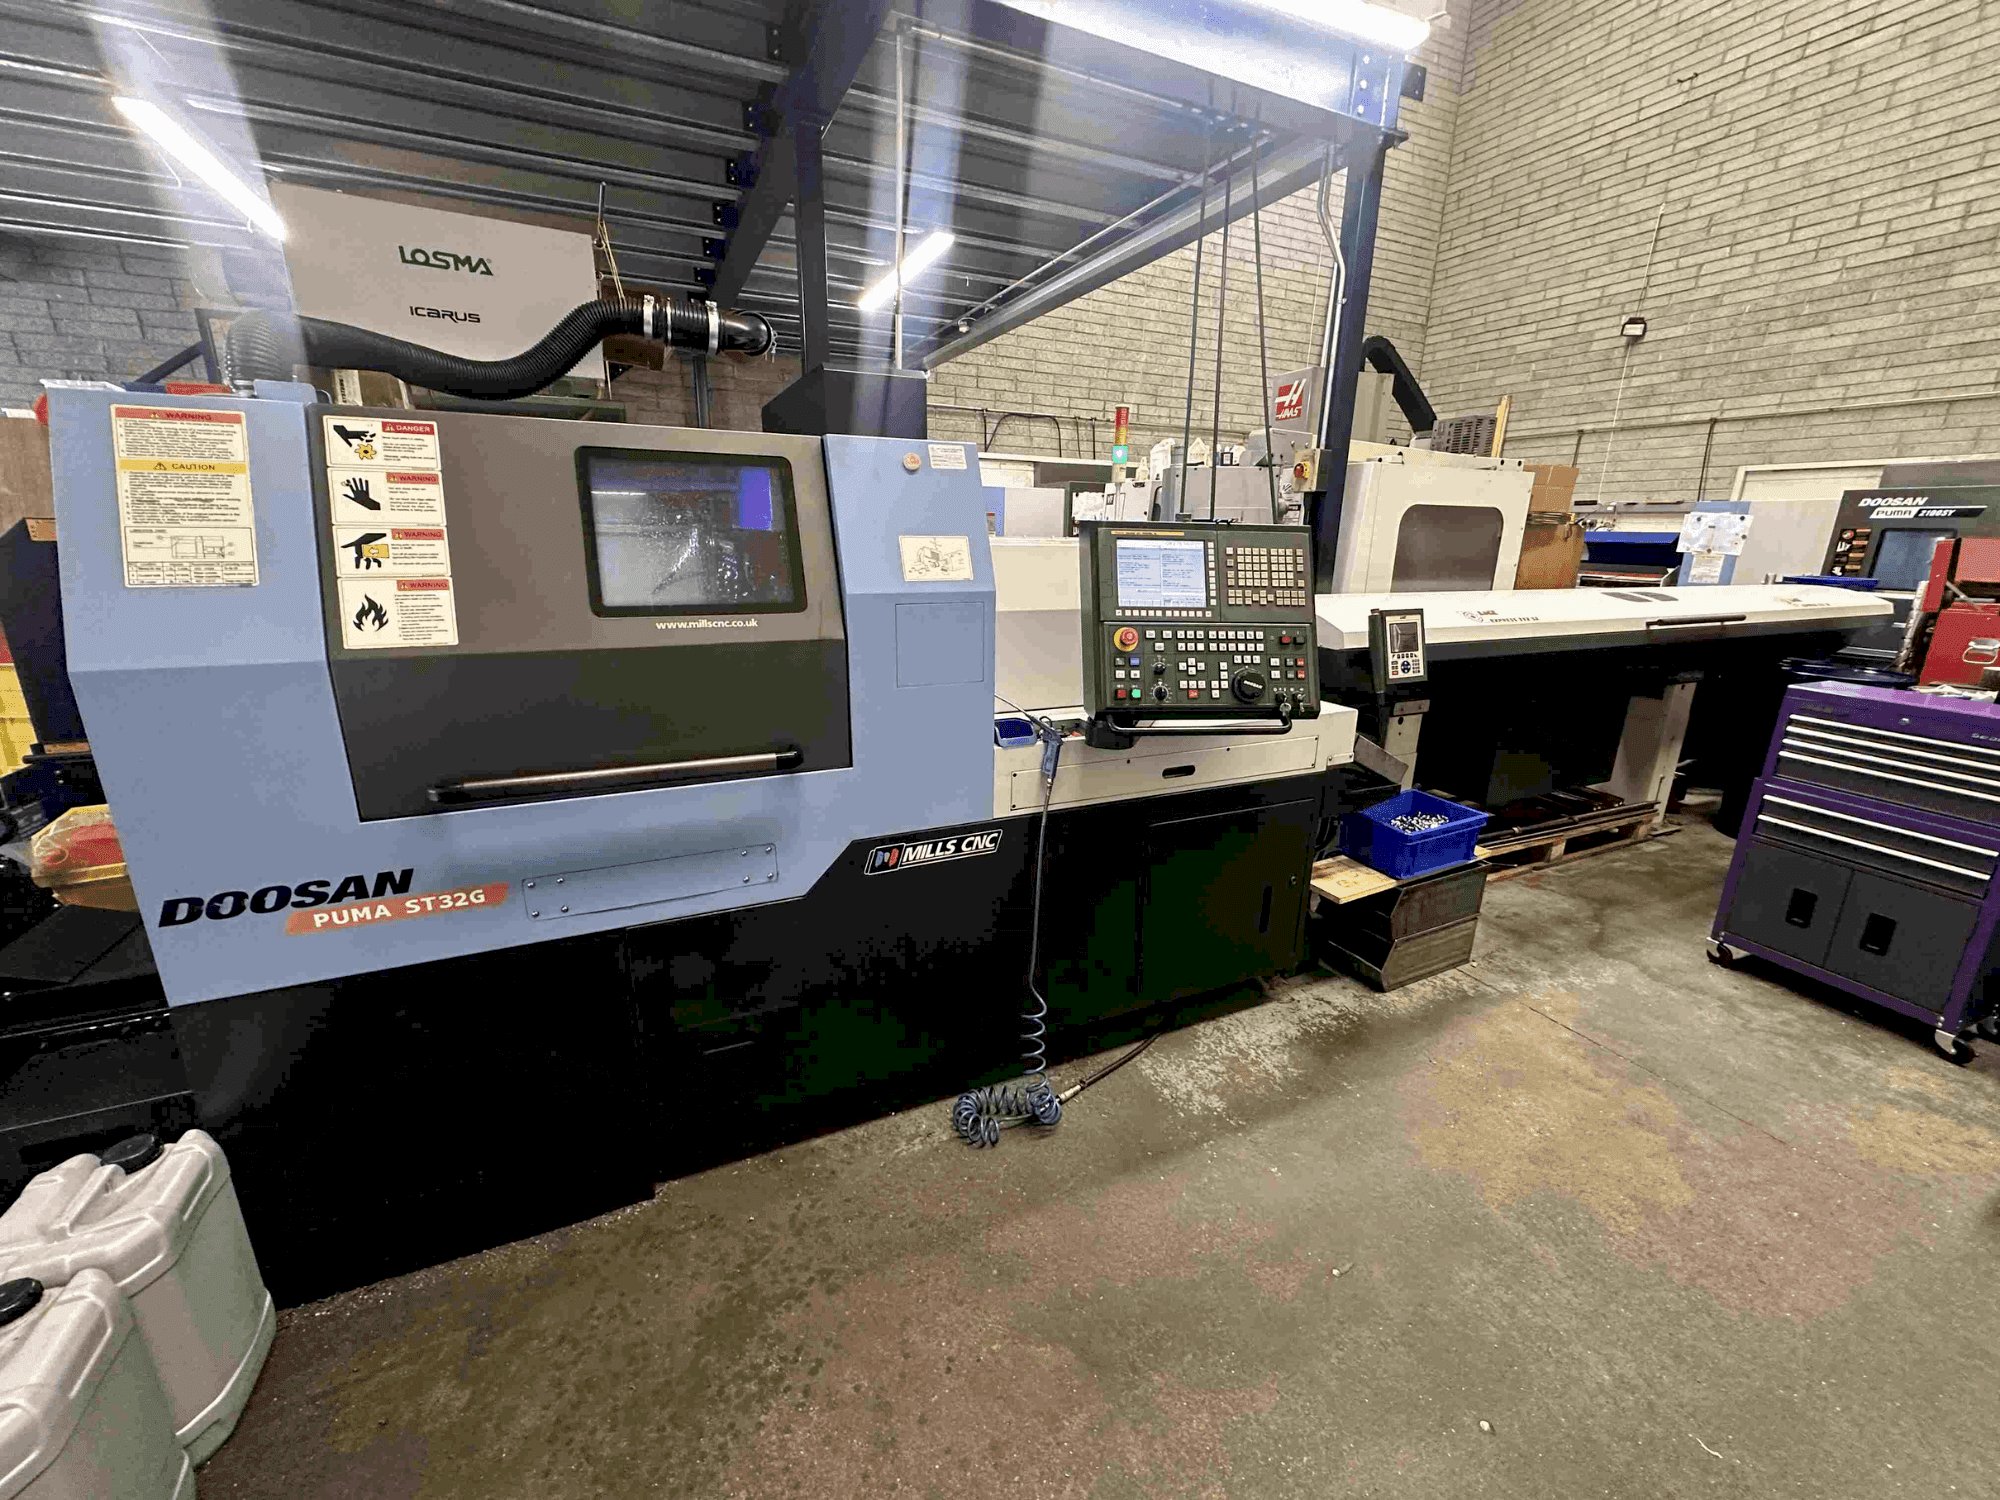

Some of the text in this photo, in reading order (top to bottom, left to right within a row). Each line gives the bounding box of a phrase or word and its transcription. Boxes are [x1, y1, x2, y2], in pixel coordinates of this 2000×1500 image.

[399, 246, 494, 276] LOSMA
[166, 411, 212, 421] WARNING
[396, 424, 431, 433] DANGER
[171, 463, 215, 471] CAUTION
[1858, 497, 1929, 507] DOOSAN
[656, 619, 758, 630] www.millscnc.co.uk
[903, 833, 999, 862] MILLS CNC
[158, 868, 414, 928] DOOSAN
[313, 889, 486, 928] PUMA ST32G
